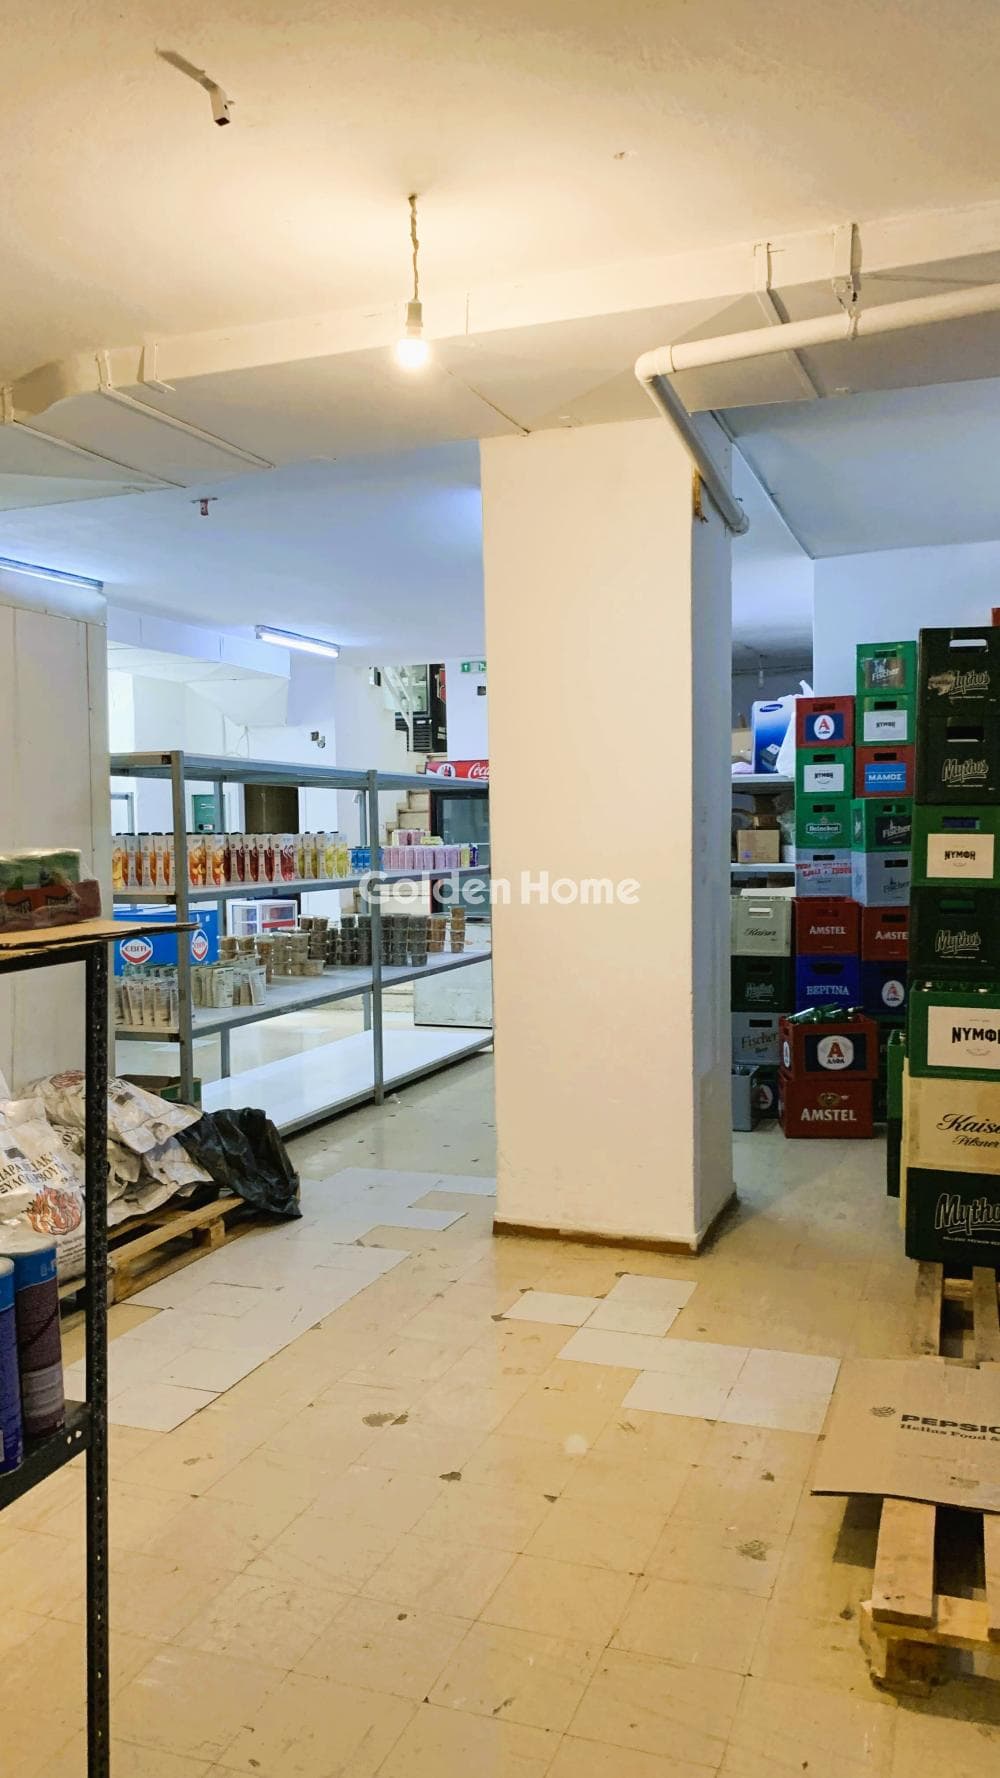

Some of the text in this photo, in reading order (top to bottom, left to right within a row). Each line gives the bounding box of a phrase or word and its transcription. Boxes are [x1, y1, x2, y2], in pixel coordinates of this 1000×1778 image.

[941, 758, 989, 783] Mythos
[809, 926, 846, 935] AMSTEL
[935, 930, 981, 954] Mythos
[952, 1026, 1000, 1044] ΝΥΜΦ
[800, 1107, 857, 1121] AMSTEL
[900, 1423, 947, 1436] Hellas
[951, 1431, 986, 1441] Food
